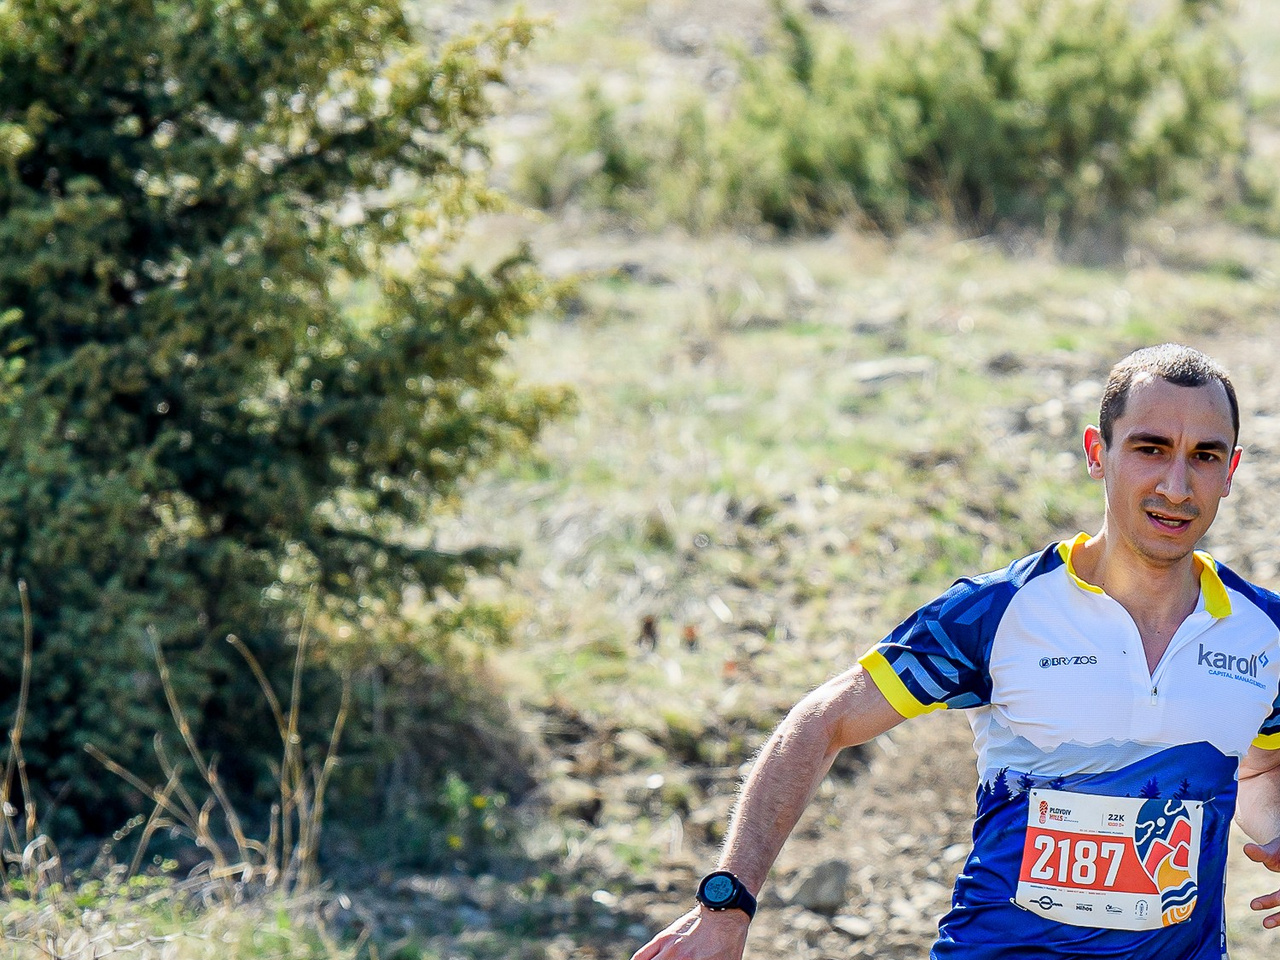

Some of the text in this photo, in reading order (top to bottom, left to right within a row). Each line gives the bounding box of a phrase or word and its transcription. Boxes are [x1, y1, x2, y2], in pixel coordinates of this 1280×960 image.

[1051, 655, 1098, 666] BRYZOS
[1198, 643, 1257, 678] karoll
[1208, 669, 1233, 679] CAPITAL
[1049, 807, 1072, 816] PLOVDIV
[1108, 813, 1125, 822] 22K
[1030, 834, 1126, 887] 2187
